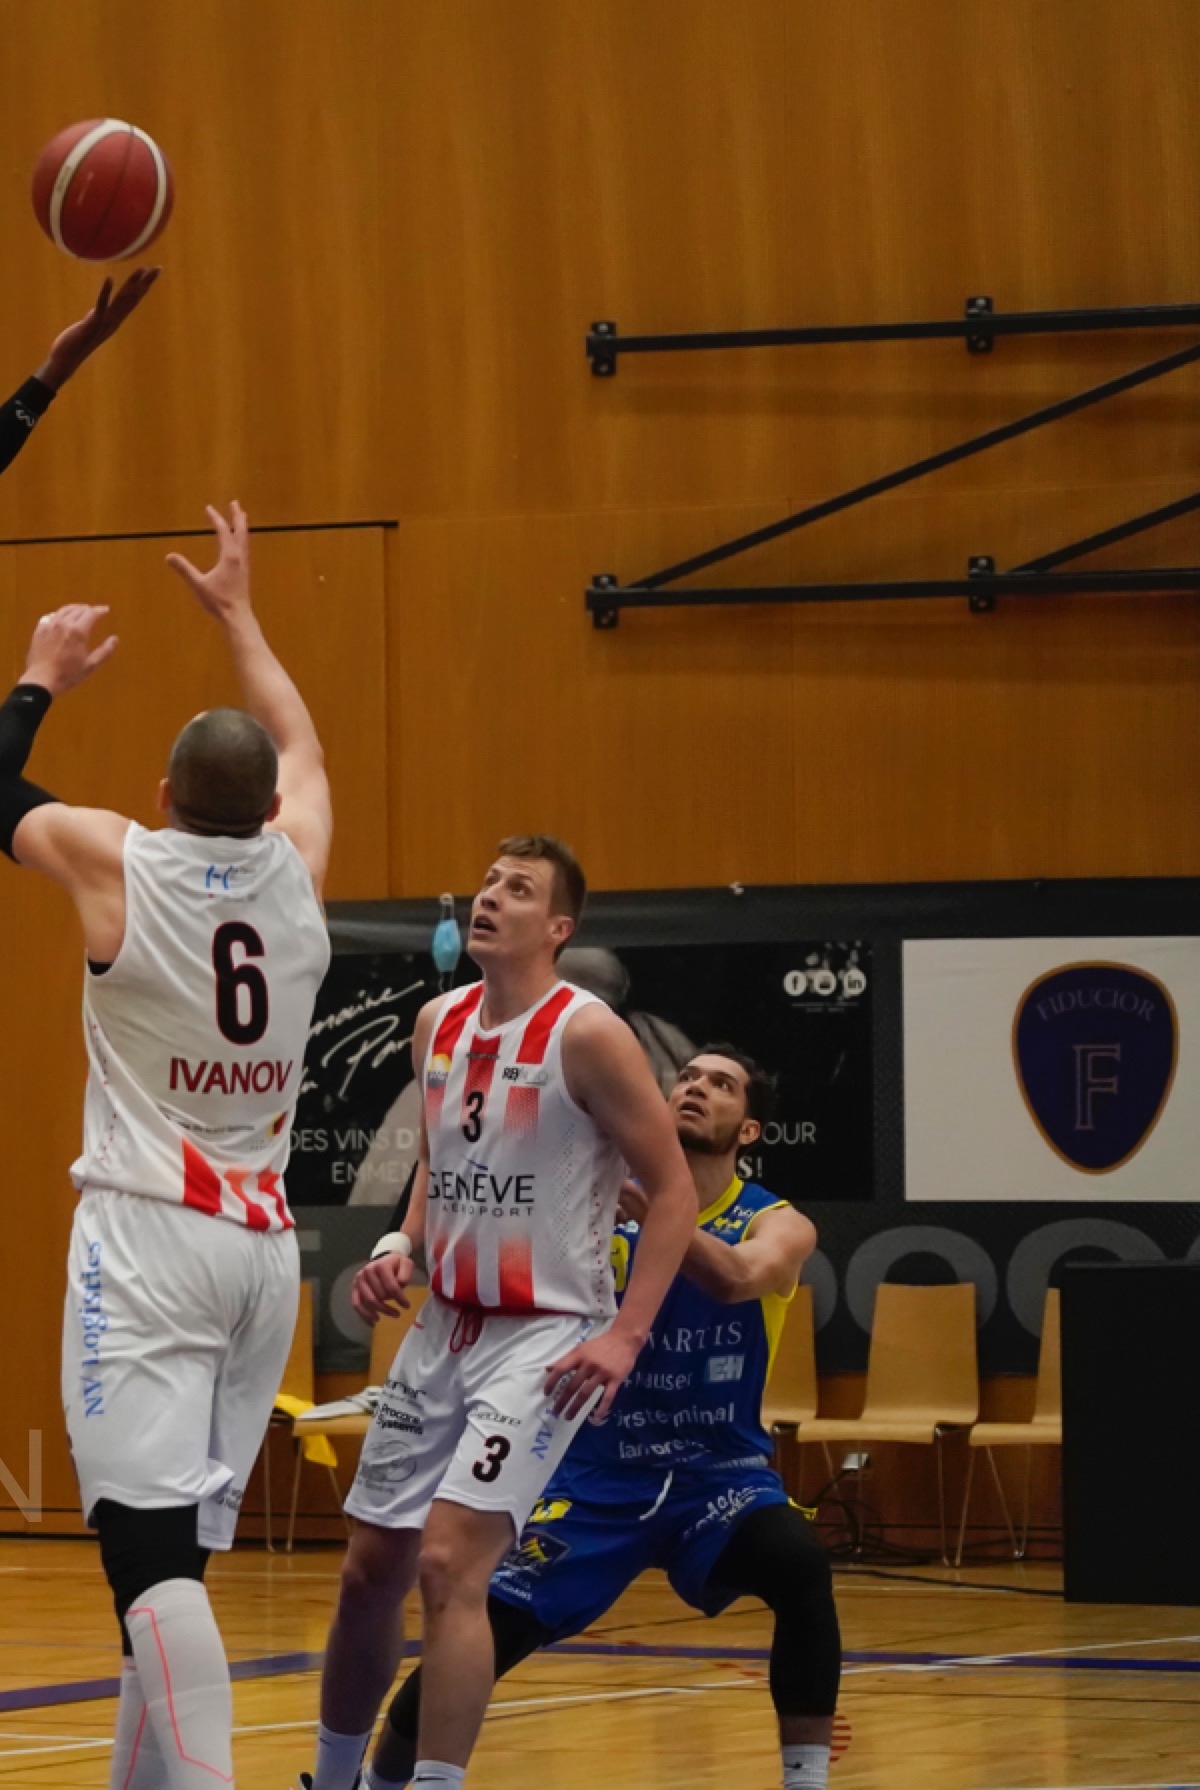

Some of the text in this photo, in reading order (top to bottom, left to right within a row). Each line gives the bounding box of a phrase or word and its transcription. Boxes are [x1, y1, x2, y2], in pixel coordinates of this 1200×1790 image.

[212, 921, 268, 1046] 6
[1035, 987, 1156, 1022] FIDUCIOR
[169, 1058, 293, 1095] IVANOV
[1073, 1043, 1121, 1131] F
[462, 1092, 484, 1143] 3
[81, 1373, 105, 1419] NV
[471, 1434, 511, 1484] 3
